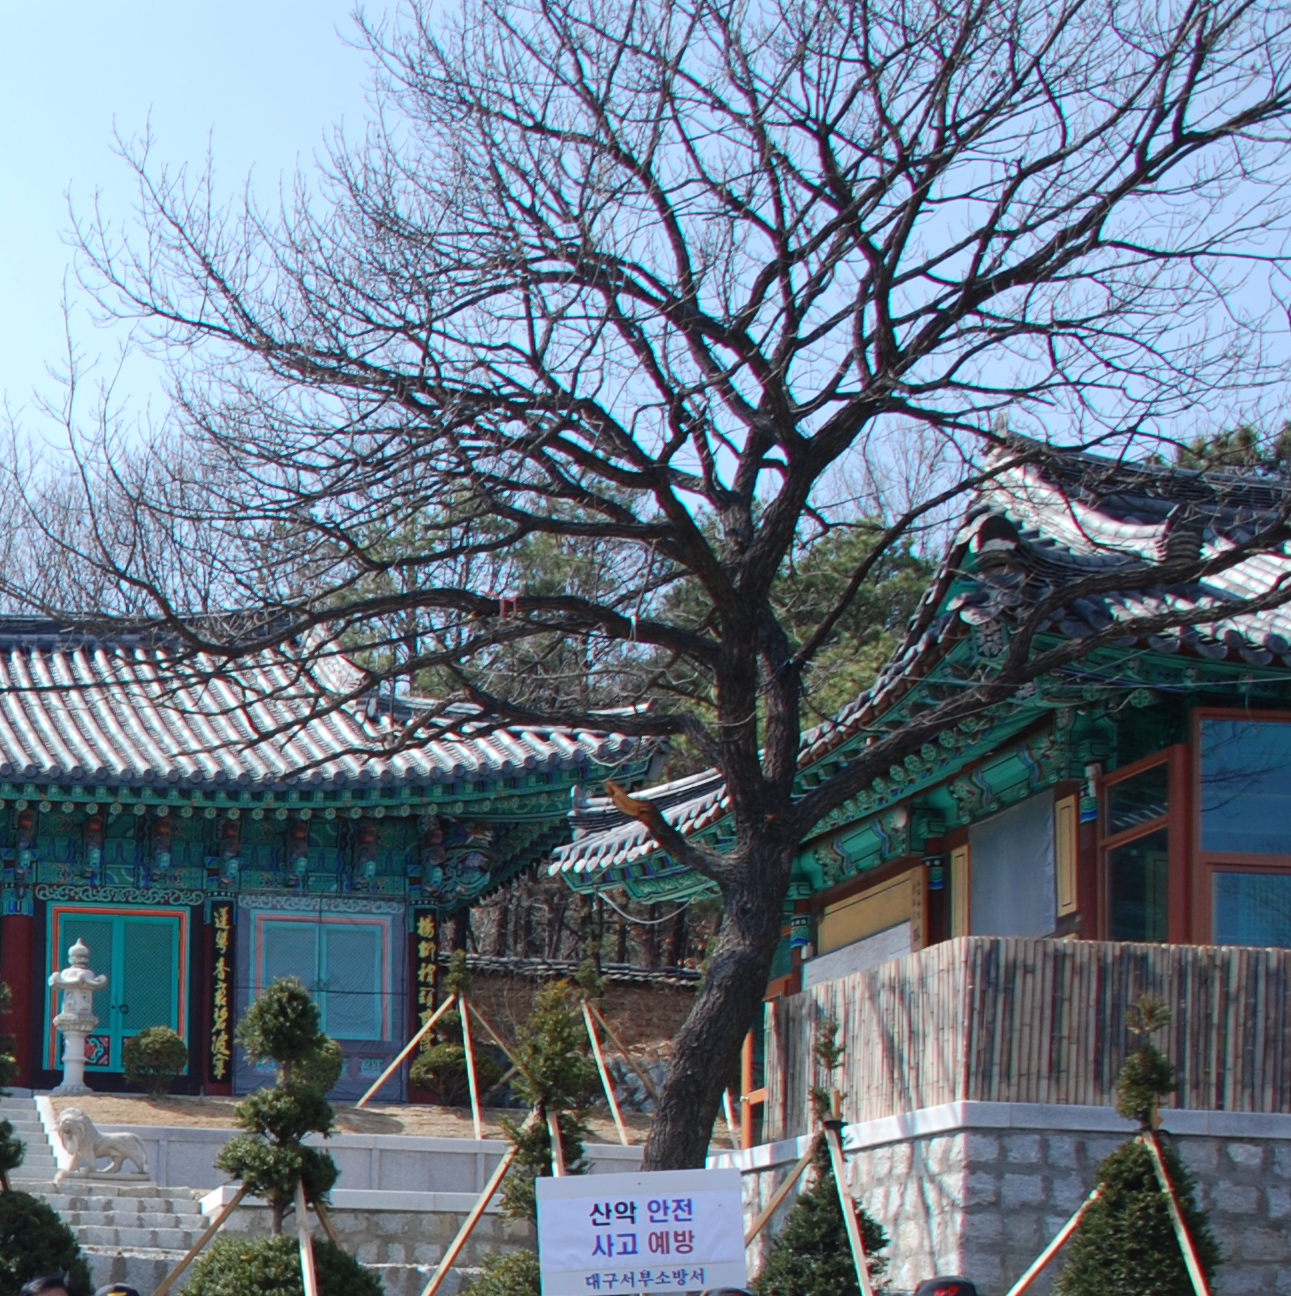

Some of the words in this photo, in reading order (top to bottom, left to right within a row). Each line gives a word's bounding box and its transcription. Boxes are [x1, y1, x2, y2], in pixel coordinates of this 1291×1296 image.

[589, 1201, 637, 1226] 산악
[647, 1198, 693, 1223] 안전
[591, 1233, 639, 1257] 사고
[648, 1229, 695, 1255] 예방
[585, 1267, 705, 1290] 대구서부소방서
